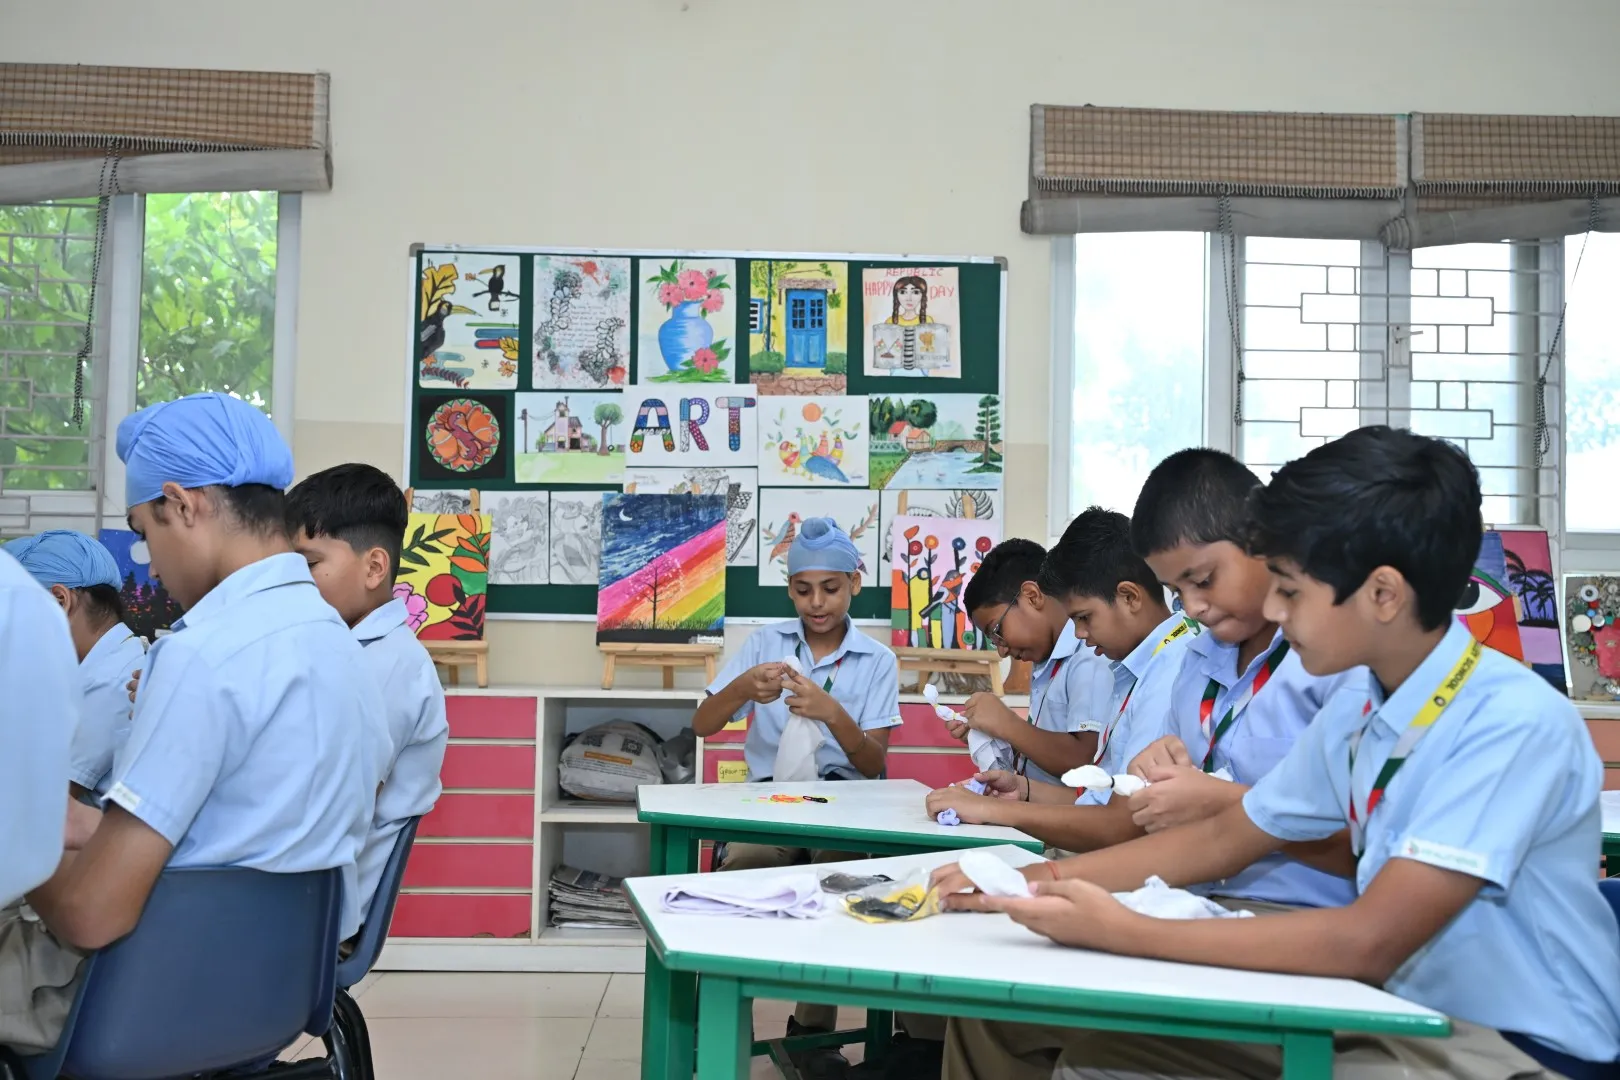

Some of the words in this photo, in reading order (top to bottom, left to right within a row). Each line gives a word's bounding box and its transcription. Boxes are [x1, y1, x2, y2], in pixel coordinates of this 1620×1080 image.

[886, 267, 943, 277] REPUBLIC
[864, 281, 893, 297] HAPPY
[930, 286, 954, 300] DAY
[629, 396, 757, 454] ART
[1446, 657, 1475, 690] SCHOOL
